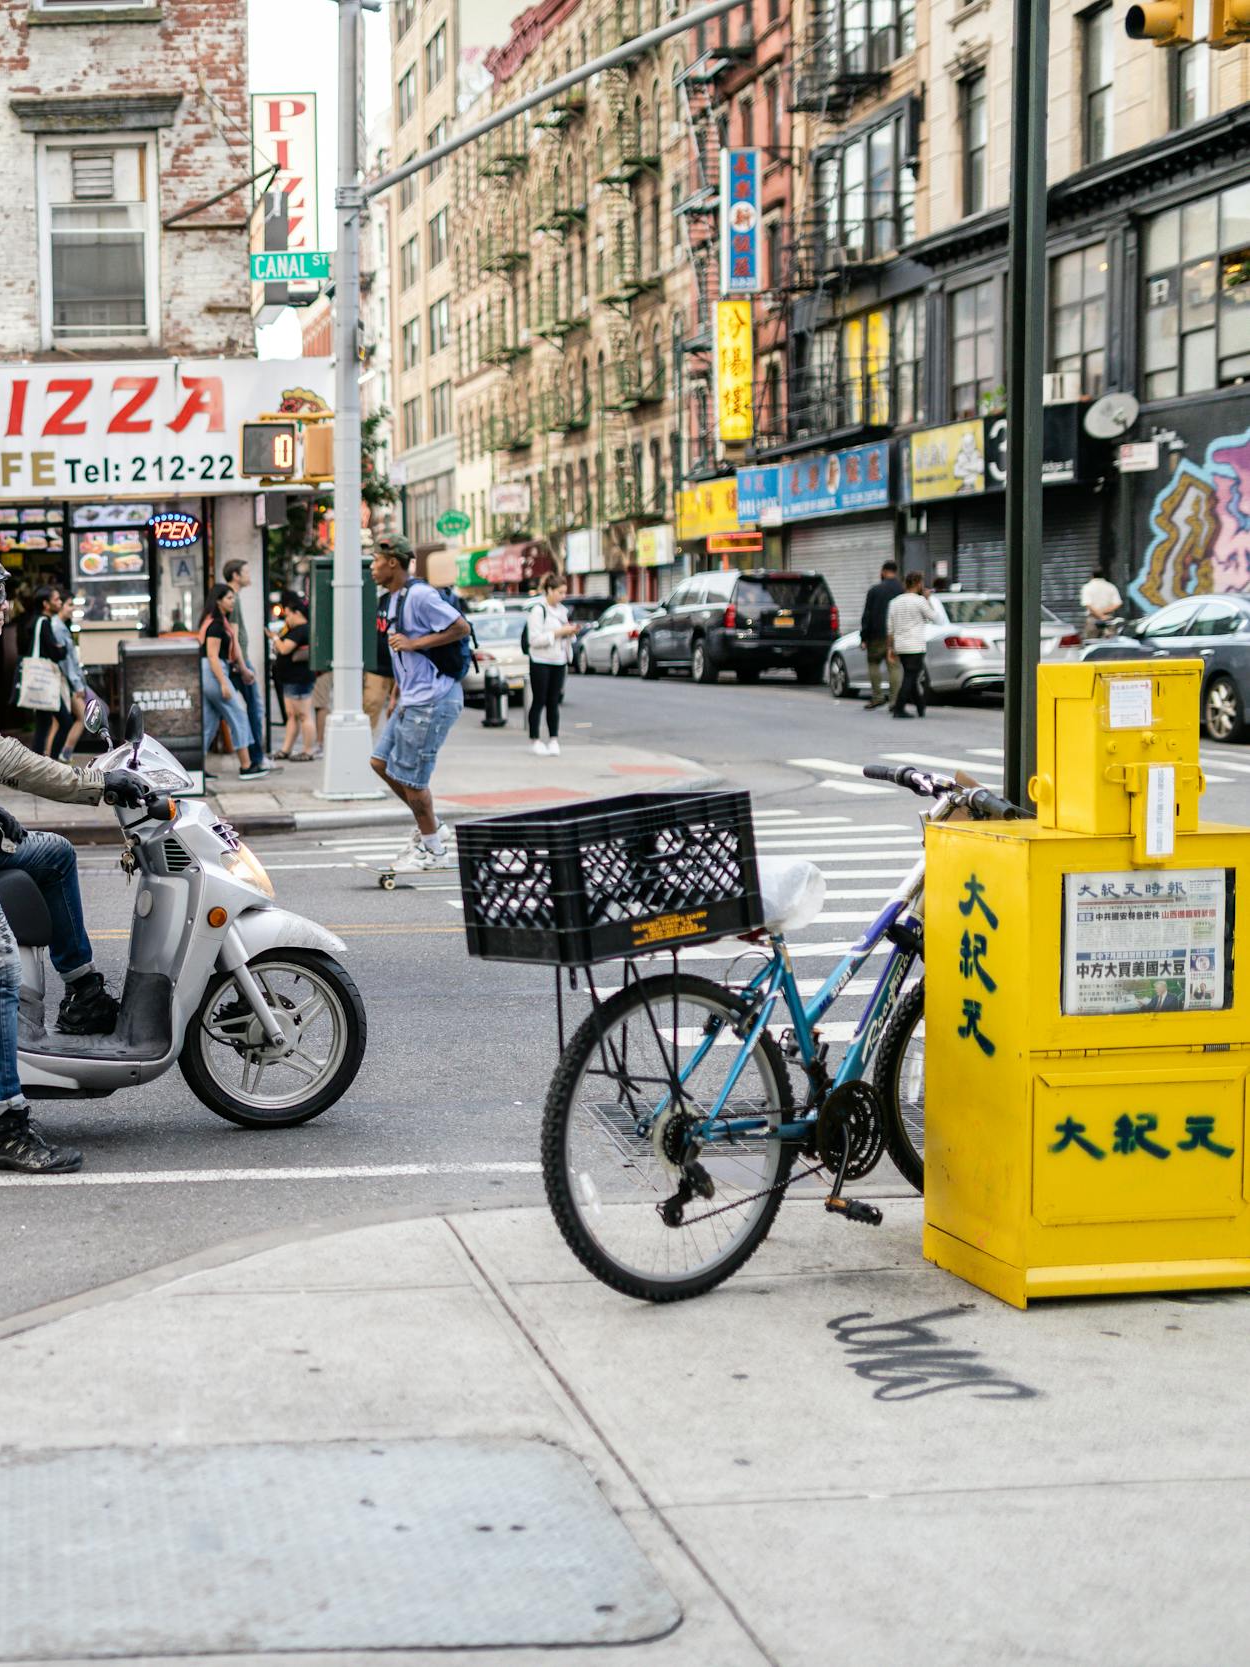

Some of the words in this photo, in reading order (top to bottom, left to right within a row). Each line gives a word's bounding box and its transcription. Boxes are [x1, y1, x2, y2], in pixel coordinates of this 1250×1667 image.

[264, 100, 307, 284] PIZZ
[254, 254, 310, 279] CANAL
[312, 254, 328, 266] ST
[273, 434, 292, 468] 10
[65, 457, 122, 484] Tel:
[176, 559, 191, 577] A
[1077, 881, 1187, 898] 大紀元時報
[958, 873, 999, 1057] 大紀元
[1076, 959, 1186, 979] 中方大買美國大豆
[861, 952, 912, 1064] Roadma
[1048, 1112, 1235, 1161] 大紀元
